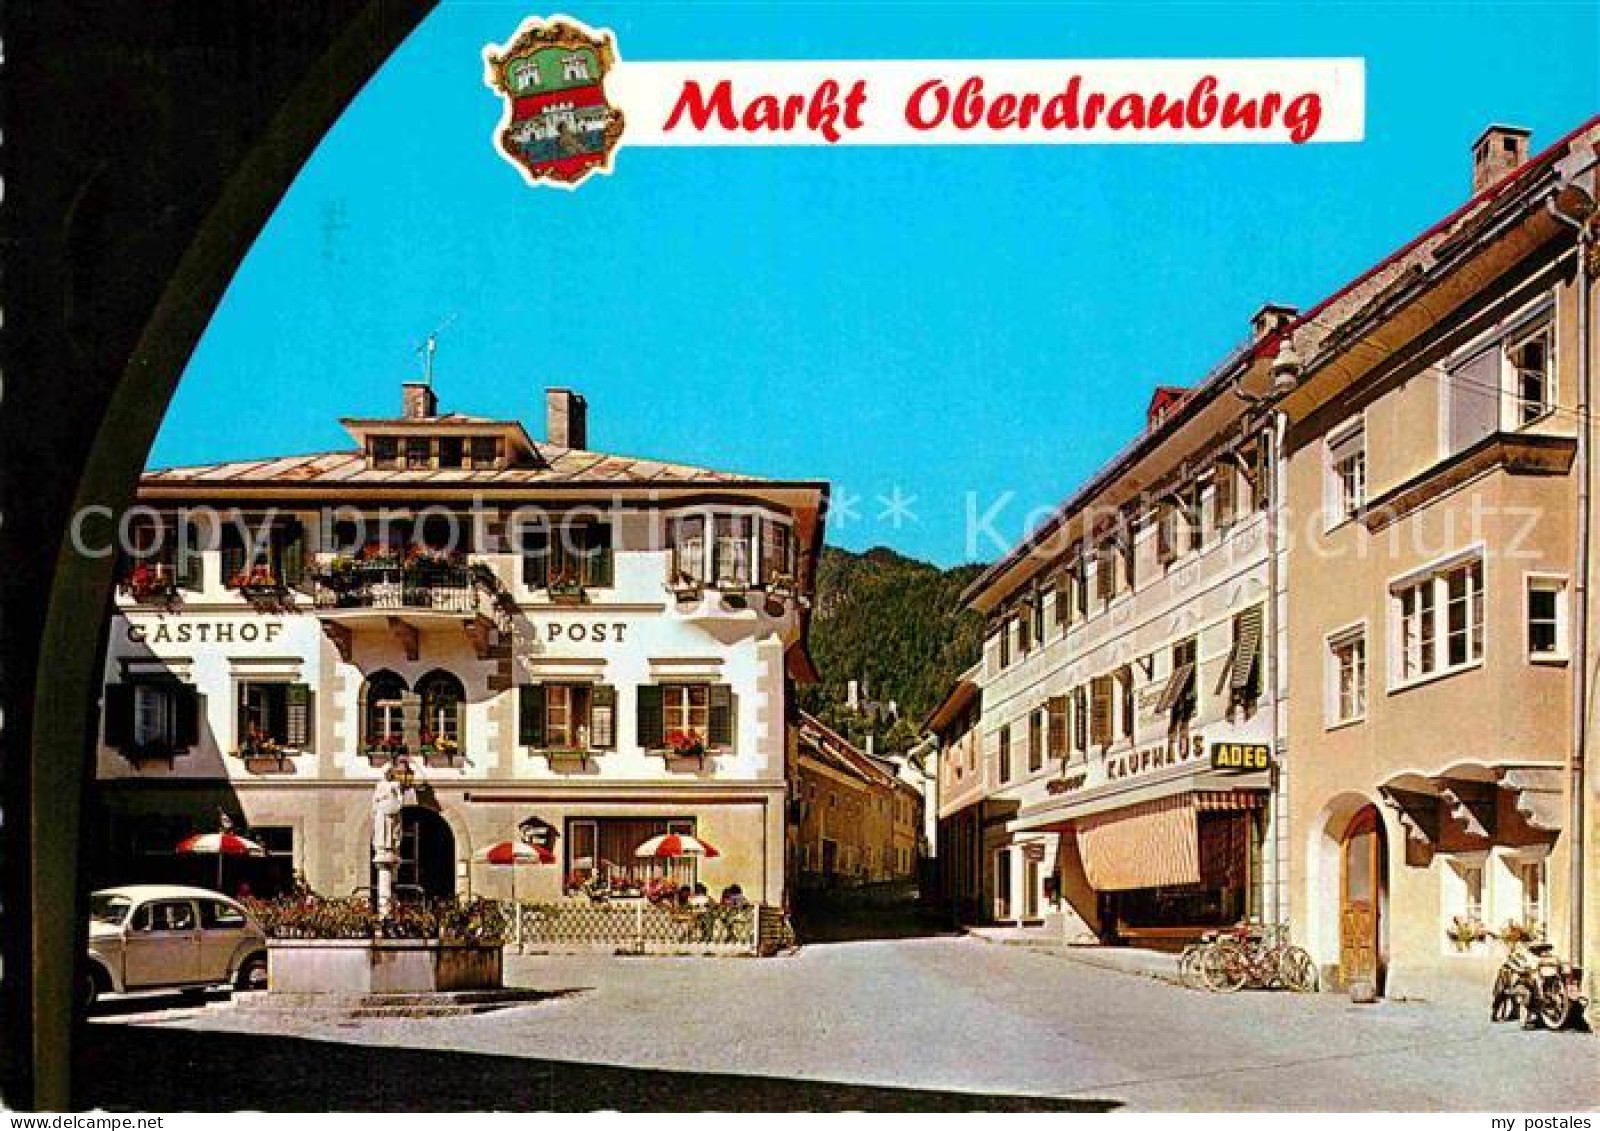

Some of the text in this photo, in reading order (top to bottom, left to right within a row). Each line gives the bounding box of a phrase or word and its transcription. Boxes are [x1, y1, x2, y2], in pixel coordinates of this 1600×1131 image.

[127, 622, 627, 643] GASTHOF POST
[1217, 744, 1268, 769] ADEG
